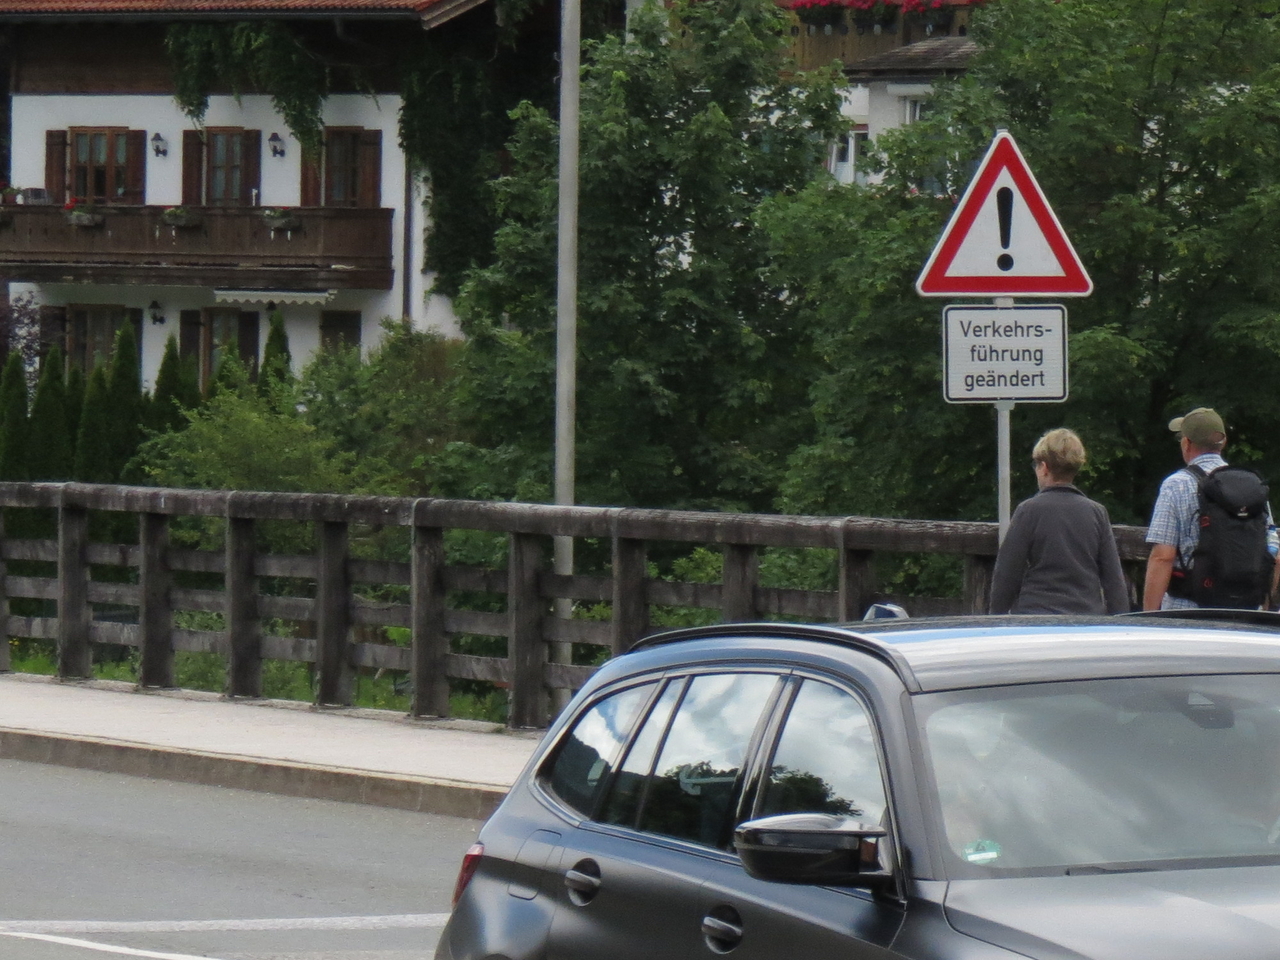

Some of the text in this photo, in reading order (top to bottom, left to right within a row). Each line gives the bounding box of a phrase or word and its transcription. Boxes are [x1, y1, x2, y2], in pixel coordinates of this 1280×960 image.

[959, 320, 1053, 338] Verkehrs-
[970, 344, 1044, 366] führung
[964, 370, 1045, 392] geändert
